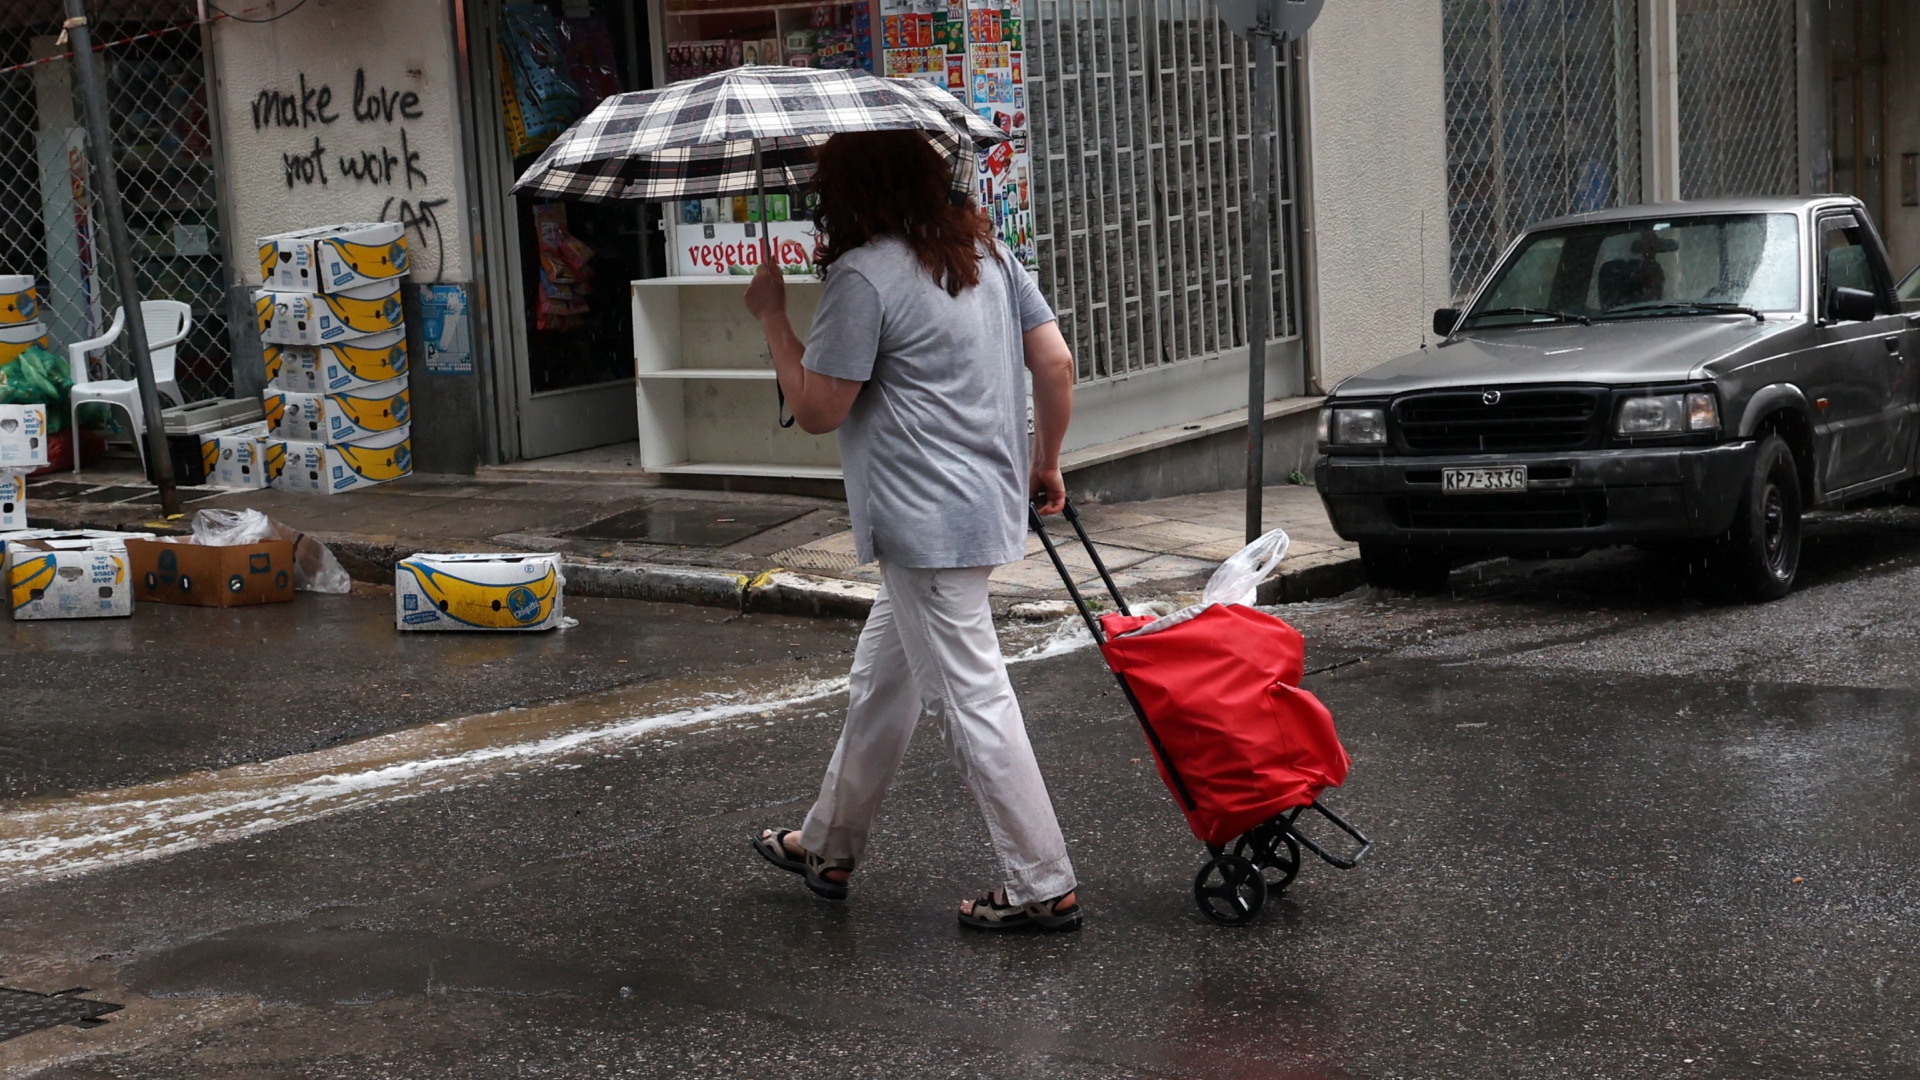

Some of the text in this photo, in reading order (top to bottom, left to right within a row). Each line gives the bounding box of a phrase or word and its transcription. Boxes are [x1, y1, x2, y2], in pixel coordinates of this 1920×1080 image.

[252, 67, 424, 133] make love
[283, 126, 428, 190] not work
